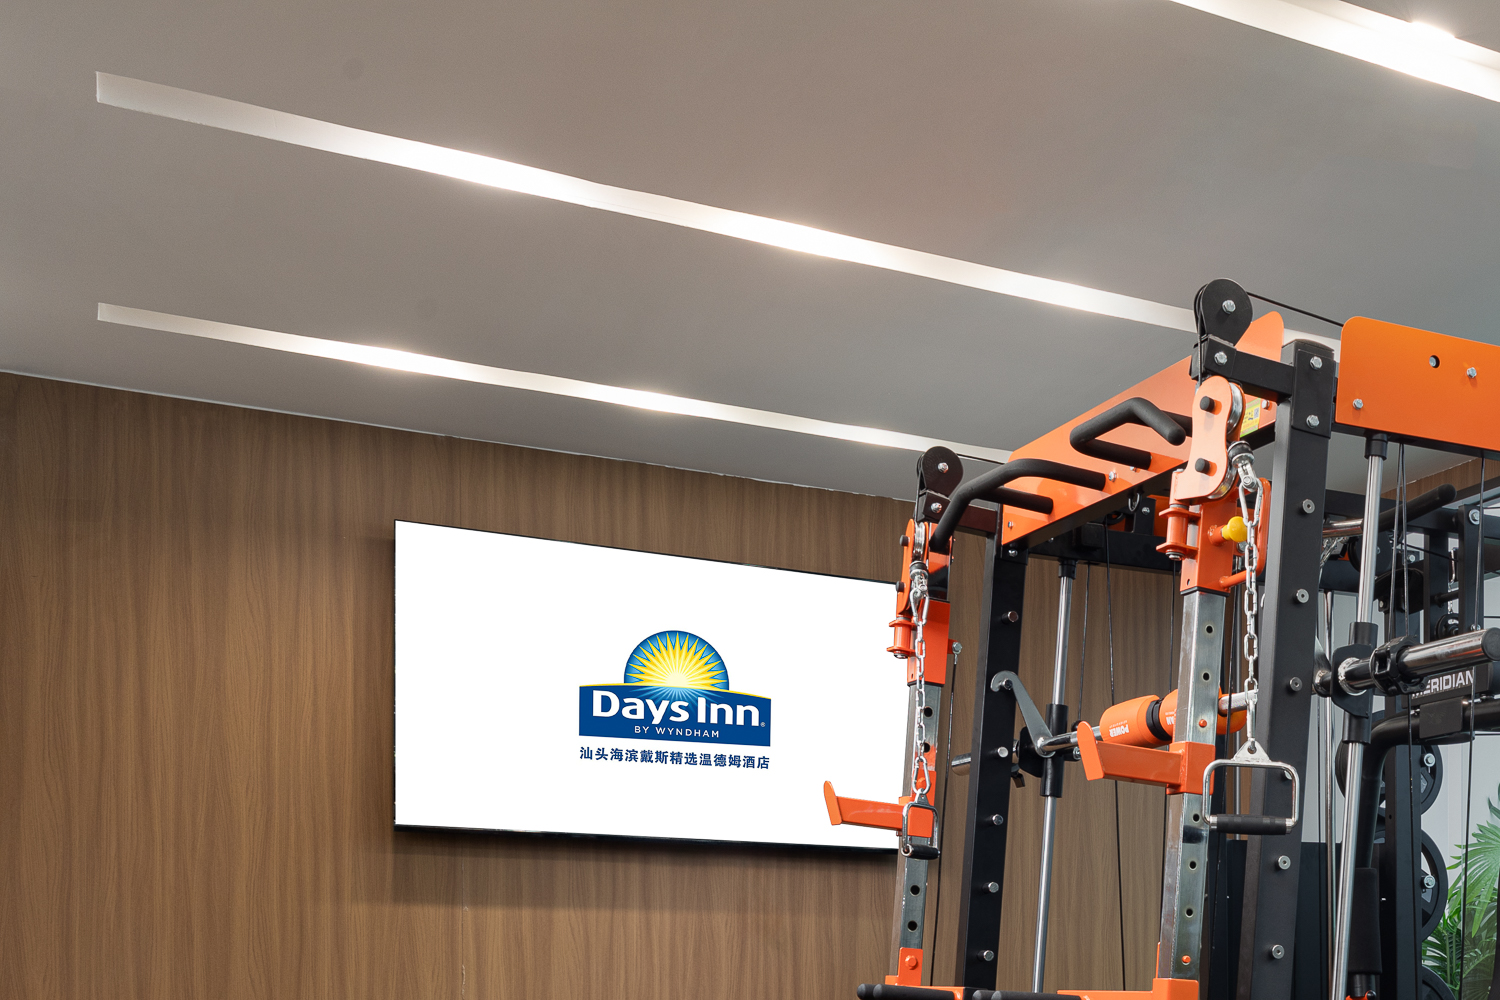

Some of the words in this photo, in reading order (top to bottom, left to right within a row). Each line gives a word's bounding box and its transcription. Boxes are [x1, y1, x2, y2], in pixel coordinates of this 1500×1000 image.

[1411, 669, 1474, 700] ERIDIAN
[592, 689, 690, 725] Days
[697, 696, 760, 727] Inn
[634, 725, 649, 734] BY
[655, 726, 720, 738] WYNDHAM
[1108, 724, 1130, 738] POWER
[579, 746, 770, 770] 汕头海滨戴斯精选温德姆酒店
